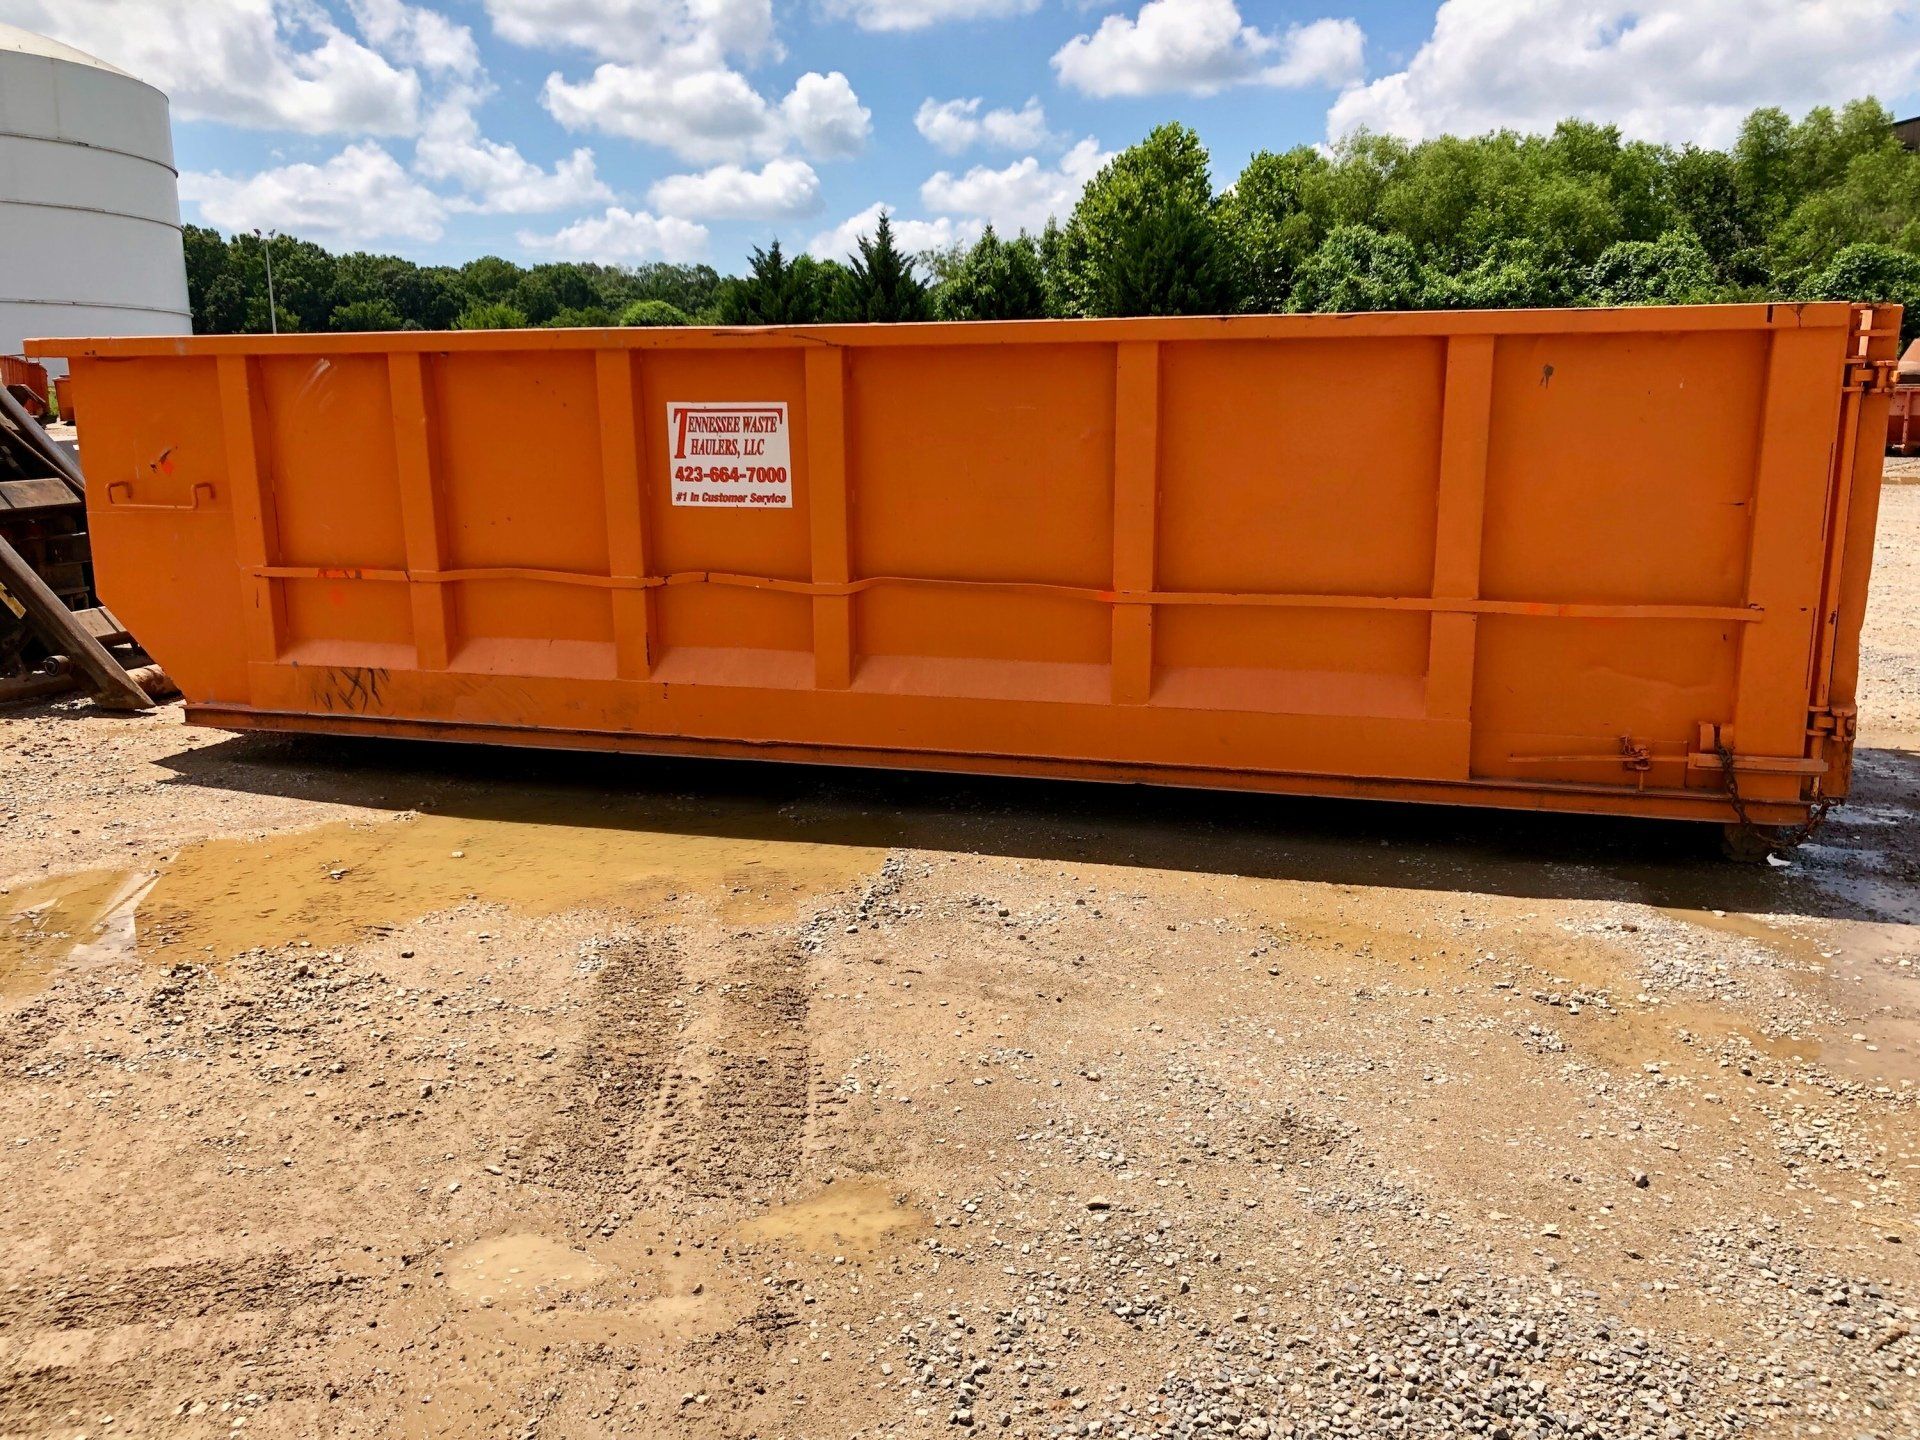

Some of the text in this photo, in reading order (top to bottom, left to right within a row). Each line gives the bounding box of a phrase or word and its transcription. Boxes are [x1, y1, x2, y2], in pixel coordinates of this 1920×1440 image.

[674, 408, 778, 458] TENNESSEE WASTE
[690, 439, 765, 458] HAULERS, LLC
[675, 466, 787, 483] 423-664-7000
[676, 492, 687, 501] #1
[702, 492, 747, 503] Customer
[749, 493, 786, 503] Service
